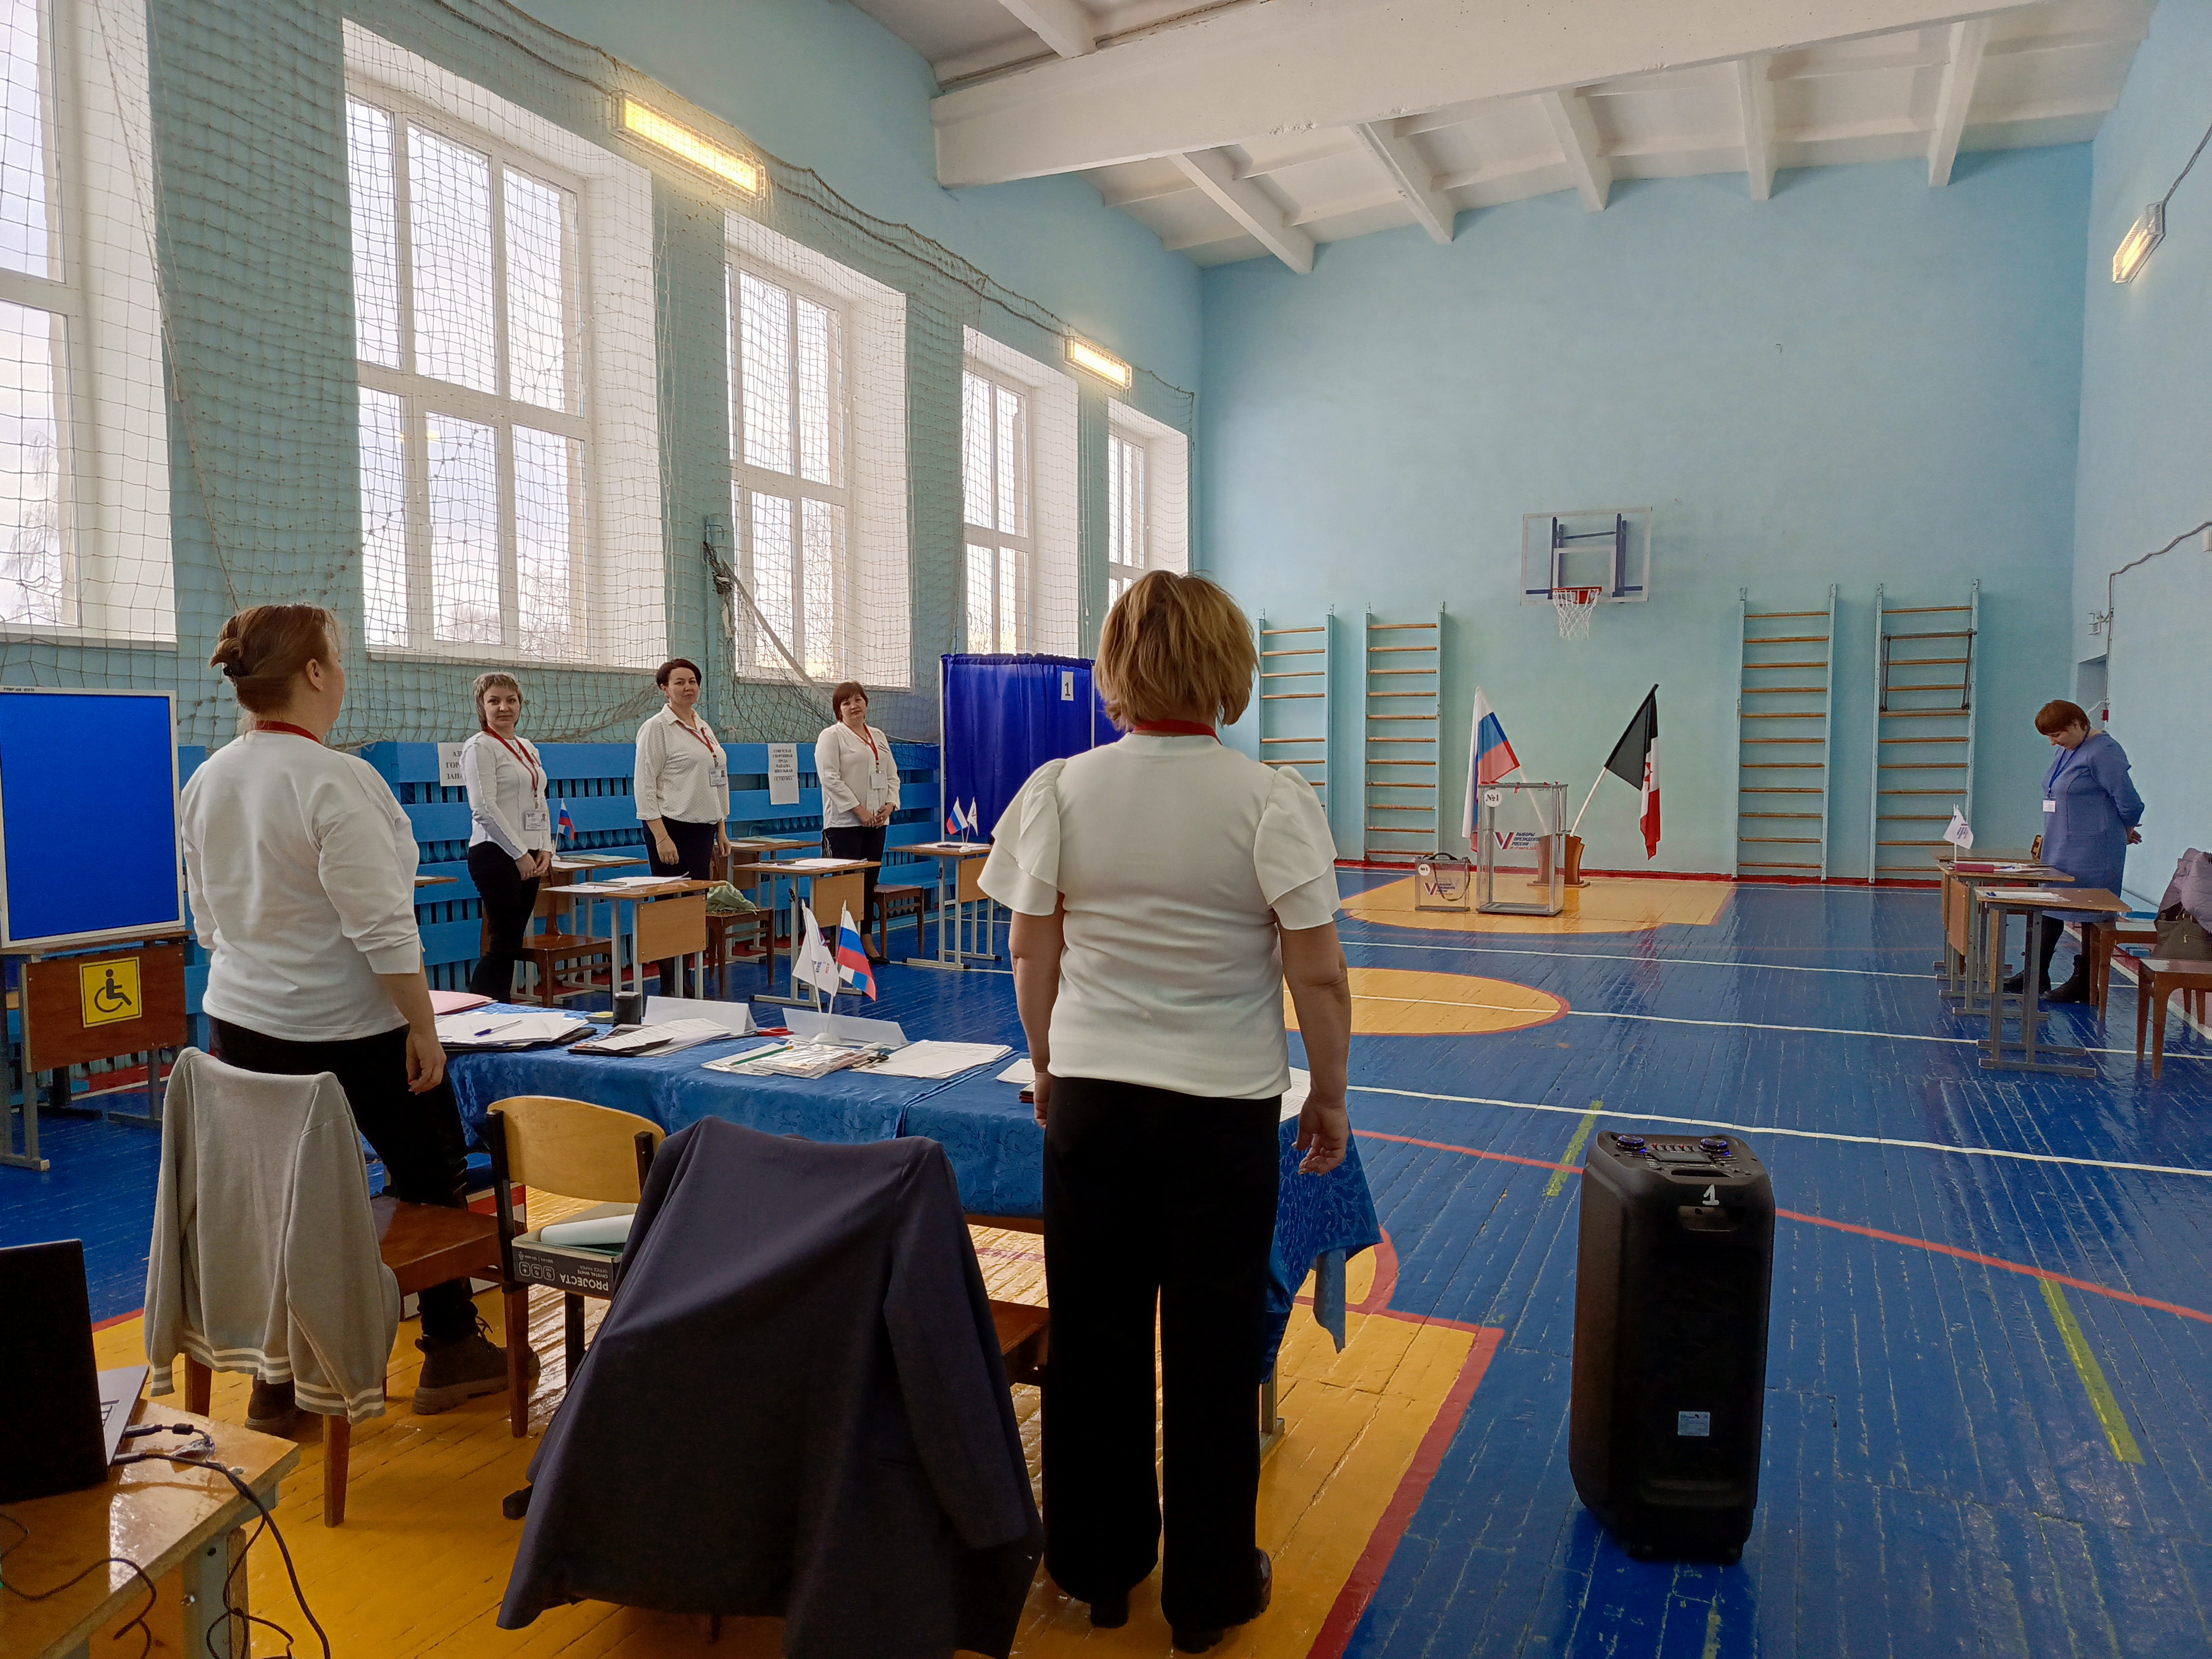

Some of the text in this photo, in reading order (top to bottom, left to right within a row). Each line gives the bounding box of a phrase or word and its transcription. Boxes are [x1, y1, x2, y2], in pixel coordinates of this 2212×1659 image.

[1065, 682, 1070, 696] 1
[1702, 1184, 1720, 1206] 1
[559, 1273, 609, 1291] PROJECTA
